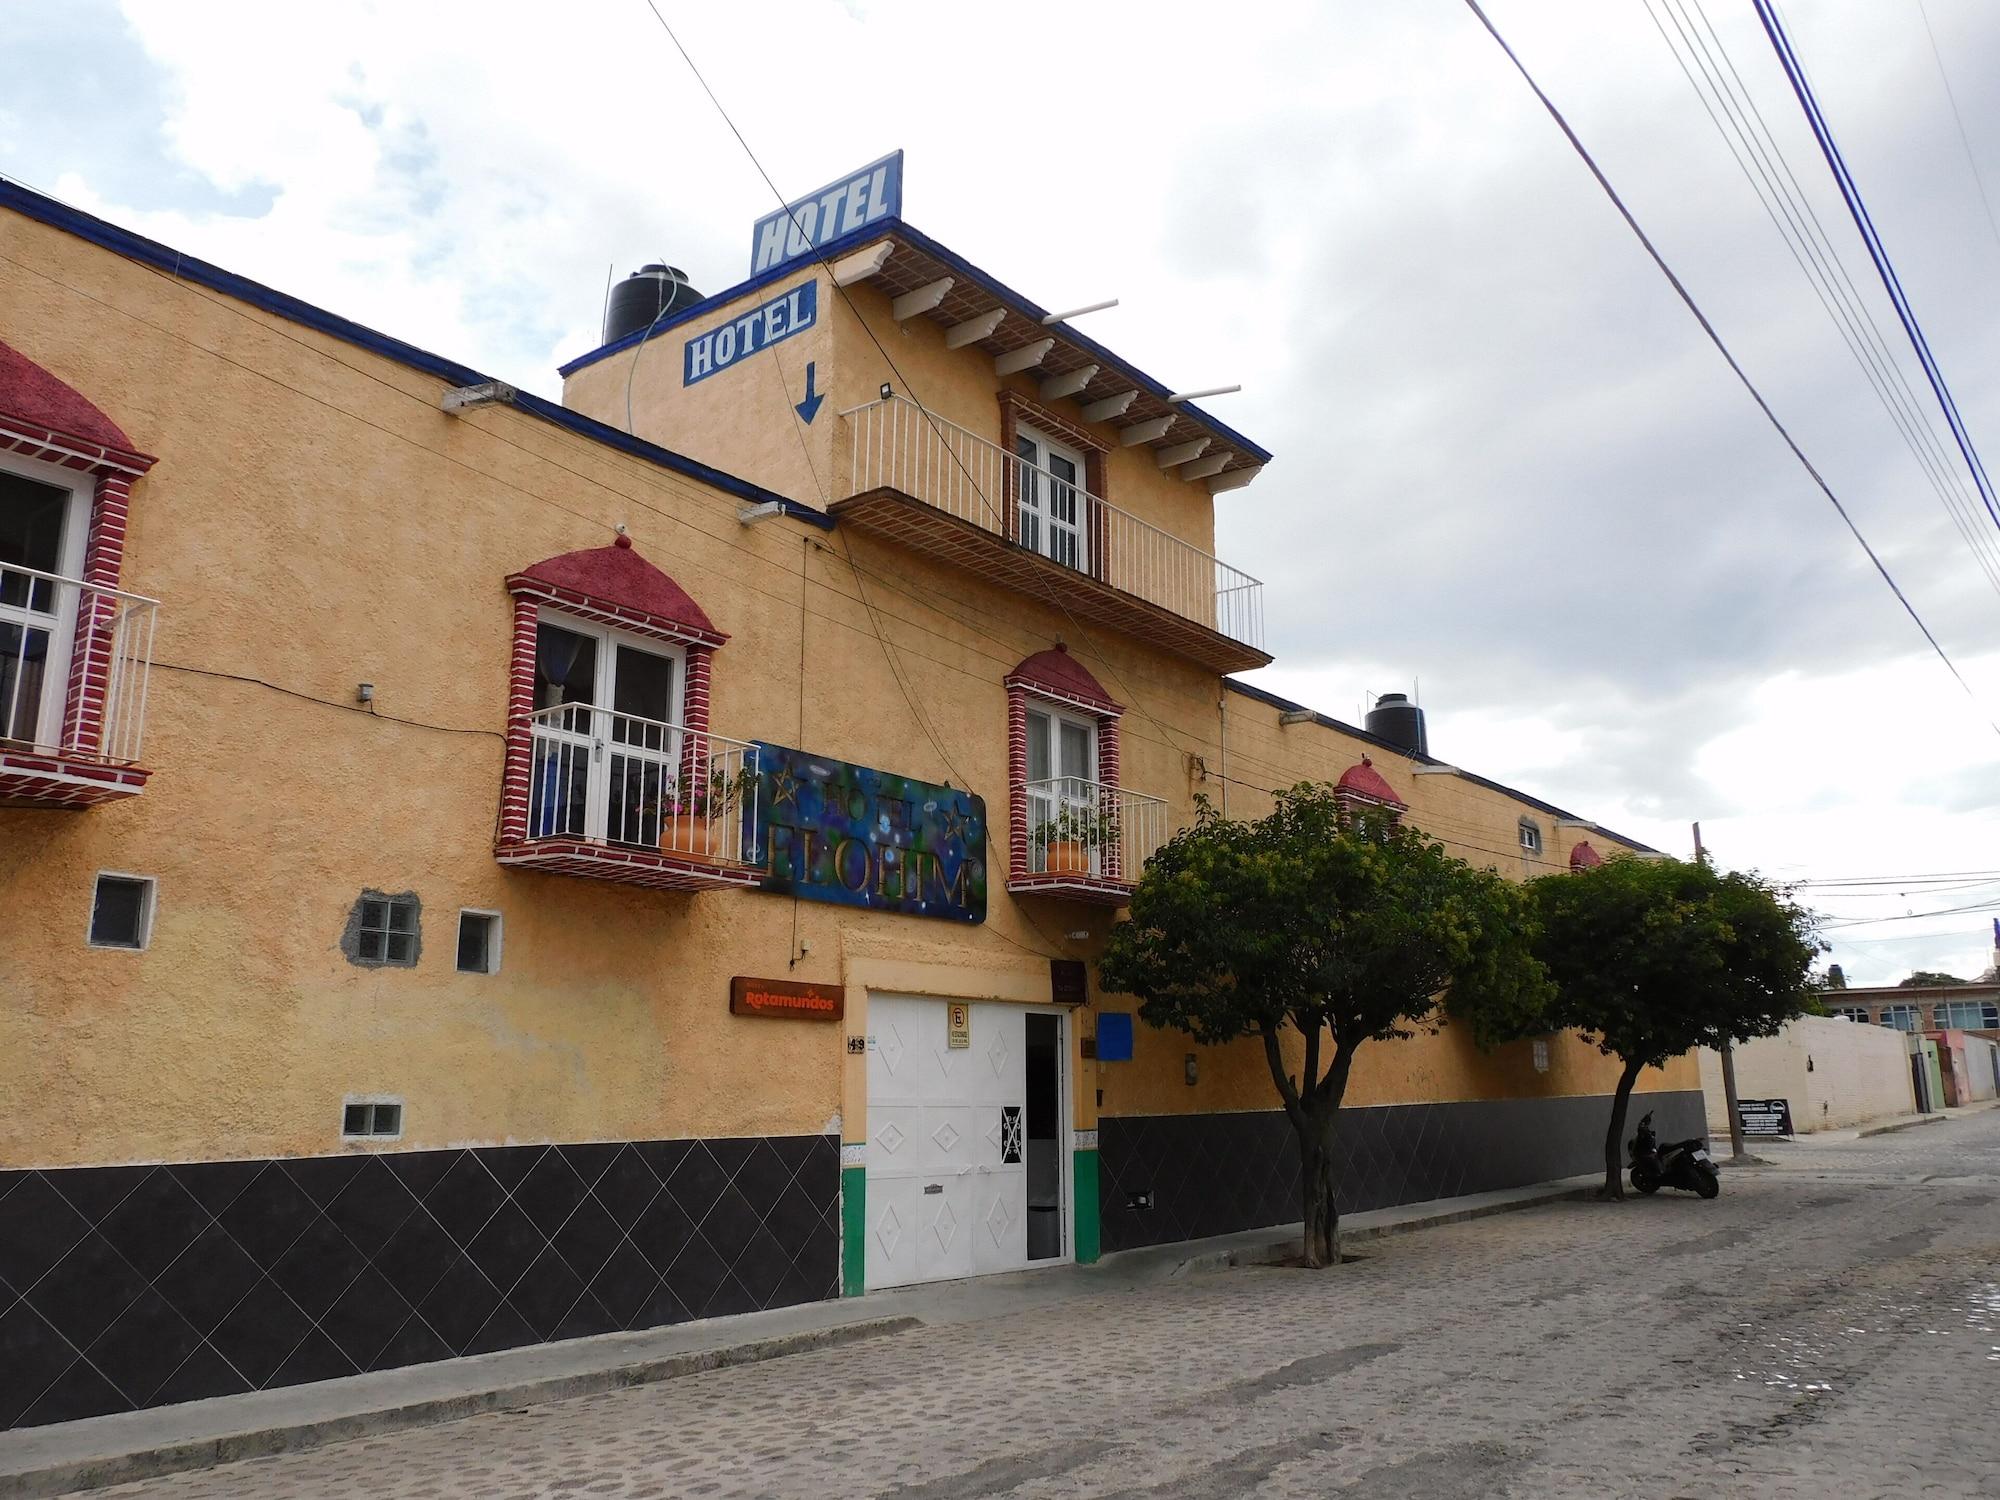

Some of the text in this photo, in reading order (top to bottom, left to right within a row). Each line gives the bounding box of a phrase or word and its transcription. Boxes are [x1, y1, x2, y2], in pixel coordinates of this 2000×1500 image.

[755, 166, 888, 273] HOTEL
[689, 290, 812, 380] HOTEL
[766, 823, 972, 908] ELOHIM
[745, 991, 834, 1011] Rotamundos
